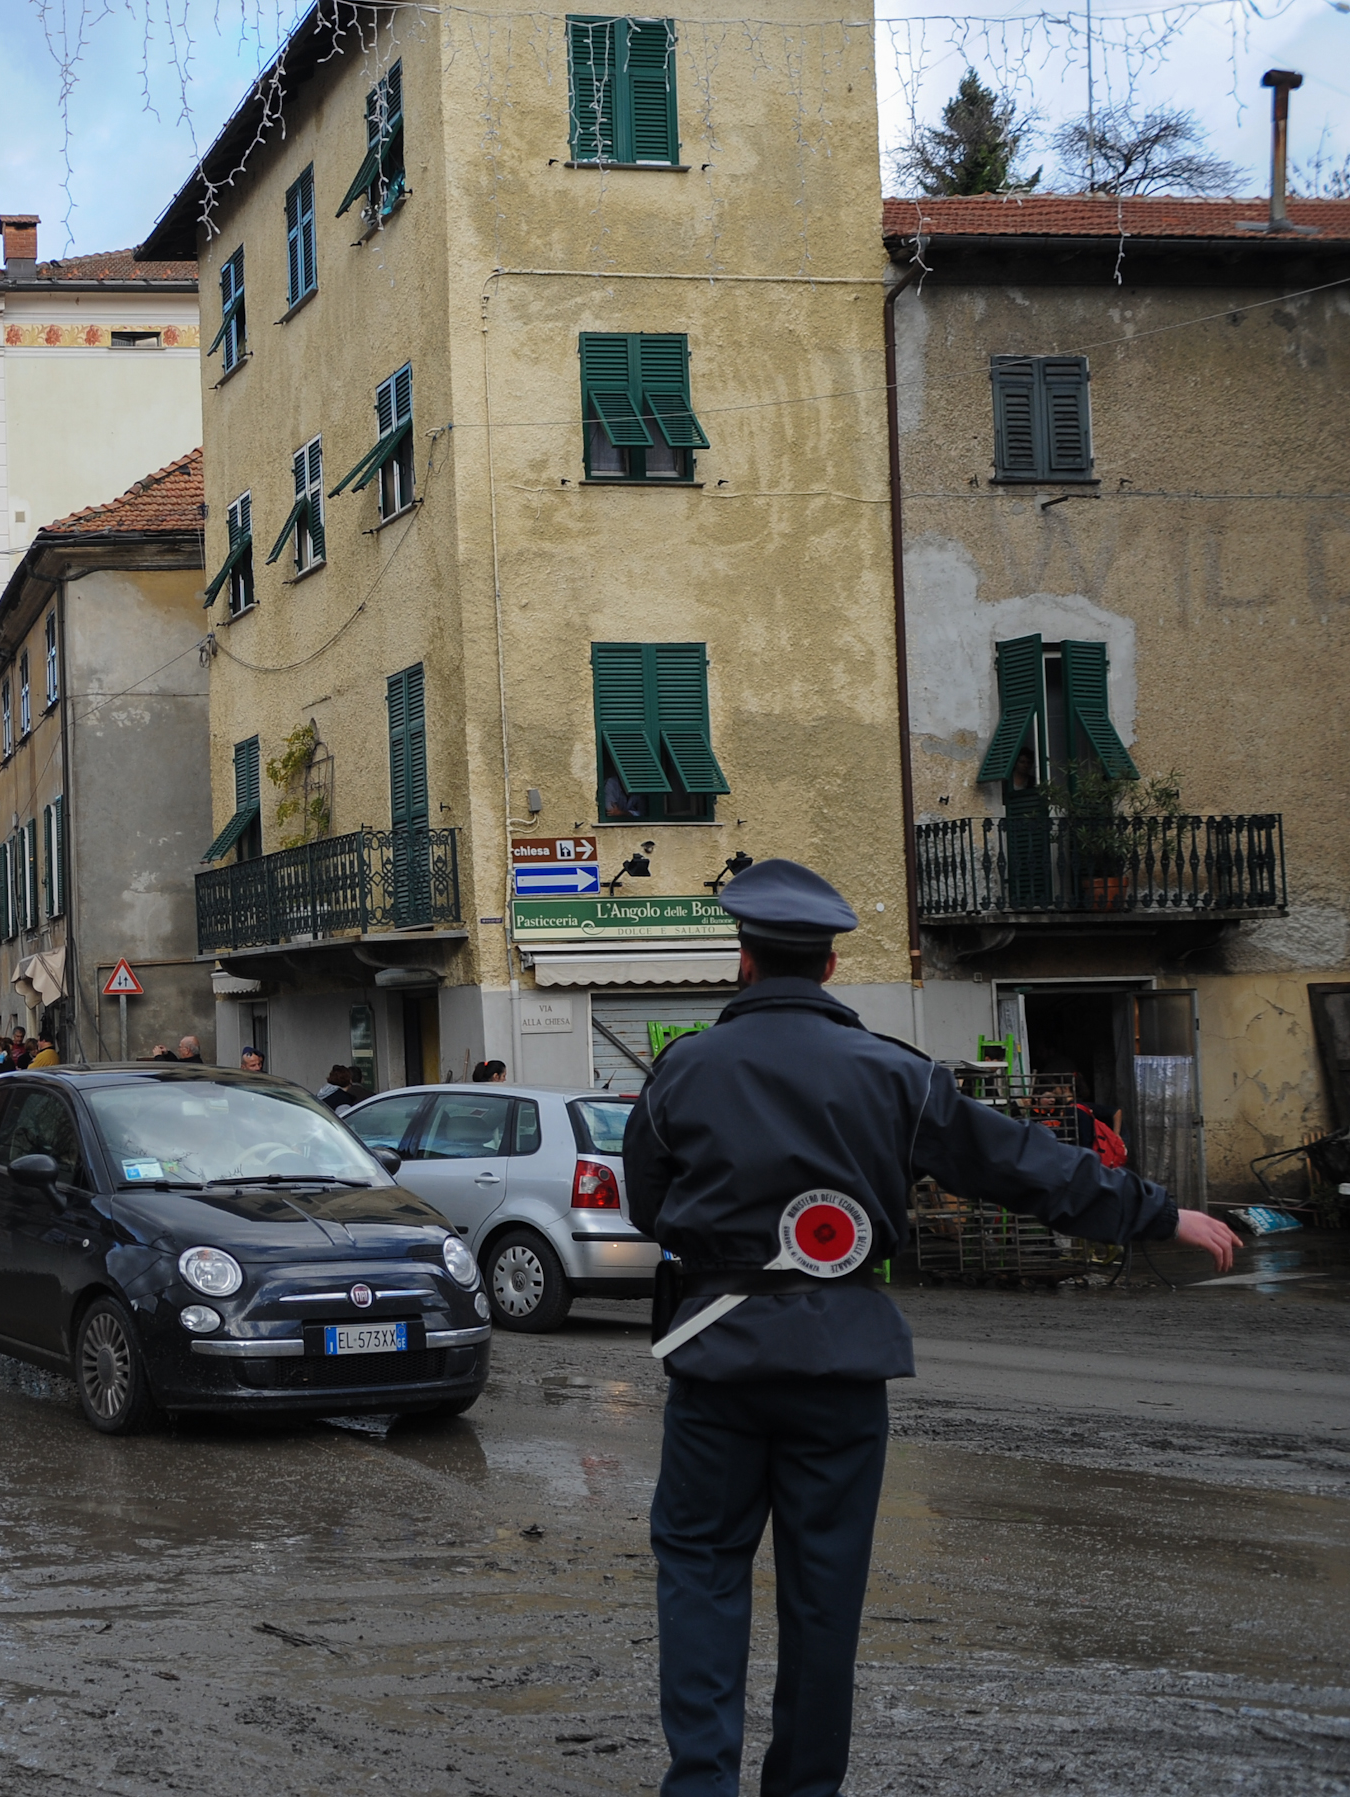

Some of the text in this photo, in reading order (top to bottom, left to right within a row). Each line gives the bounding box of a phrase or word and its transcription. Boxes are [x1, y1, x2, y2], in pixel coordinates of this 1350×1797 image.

[596, 901, 729, 923] L'Angolo delle Bont
[516, 914, 578, 927] Pasticceria
[617, 927, 653, 936] DOLCE
[675, 926, 716, 935] SALATO
[539, 1005, 553, 1013] VIA
[522, 1018, 571, 1026] ALLA CHIESA
[787, 1194, 819, 1219] MINISTERO
[838, 1198, 865, 1227] ECONOMIA
[853, 1236, 867, 1256] DELLE
[796, 1256, 820, 1272] FINANZA
[831, 1254, 857, 1273] FINANZE
[354, 1290, 368, 1302] FIAT
